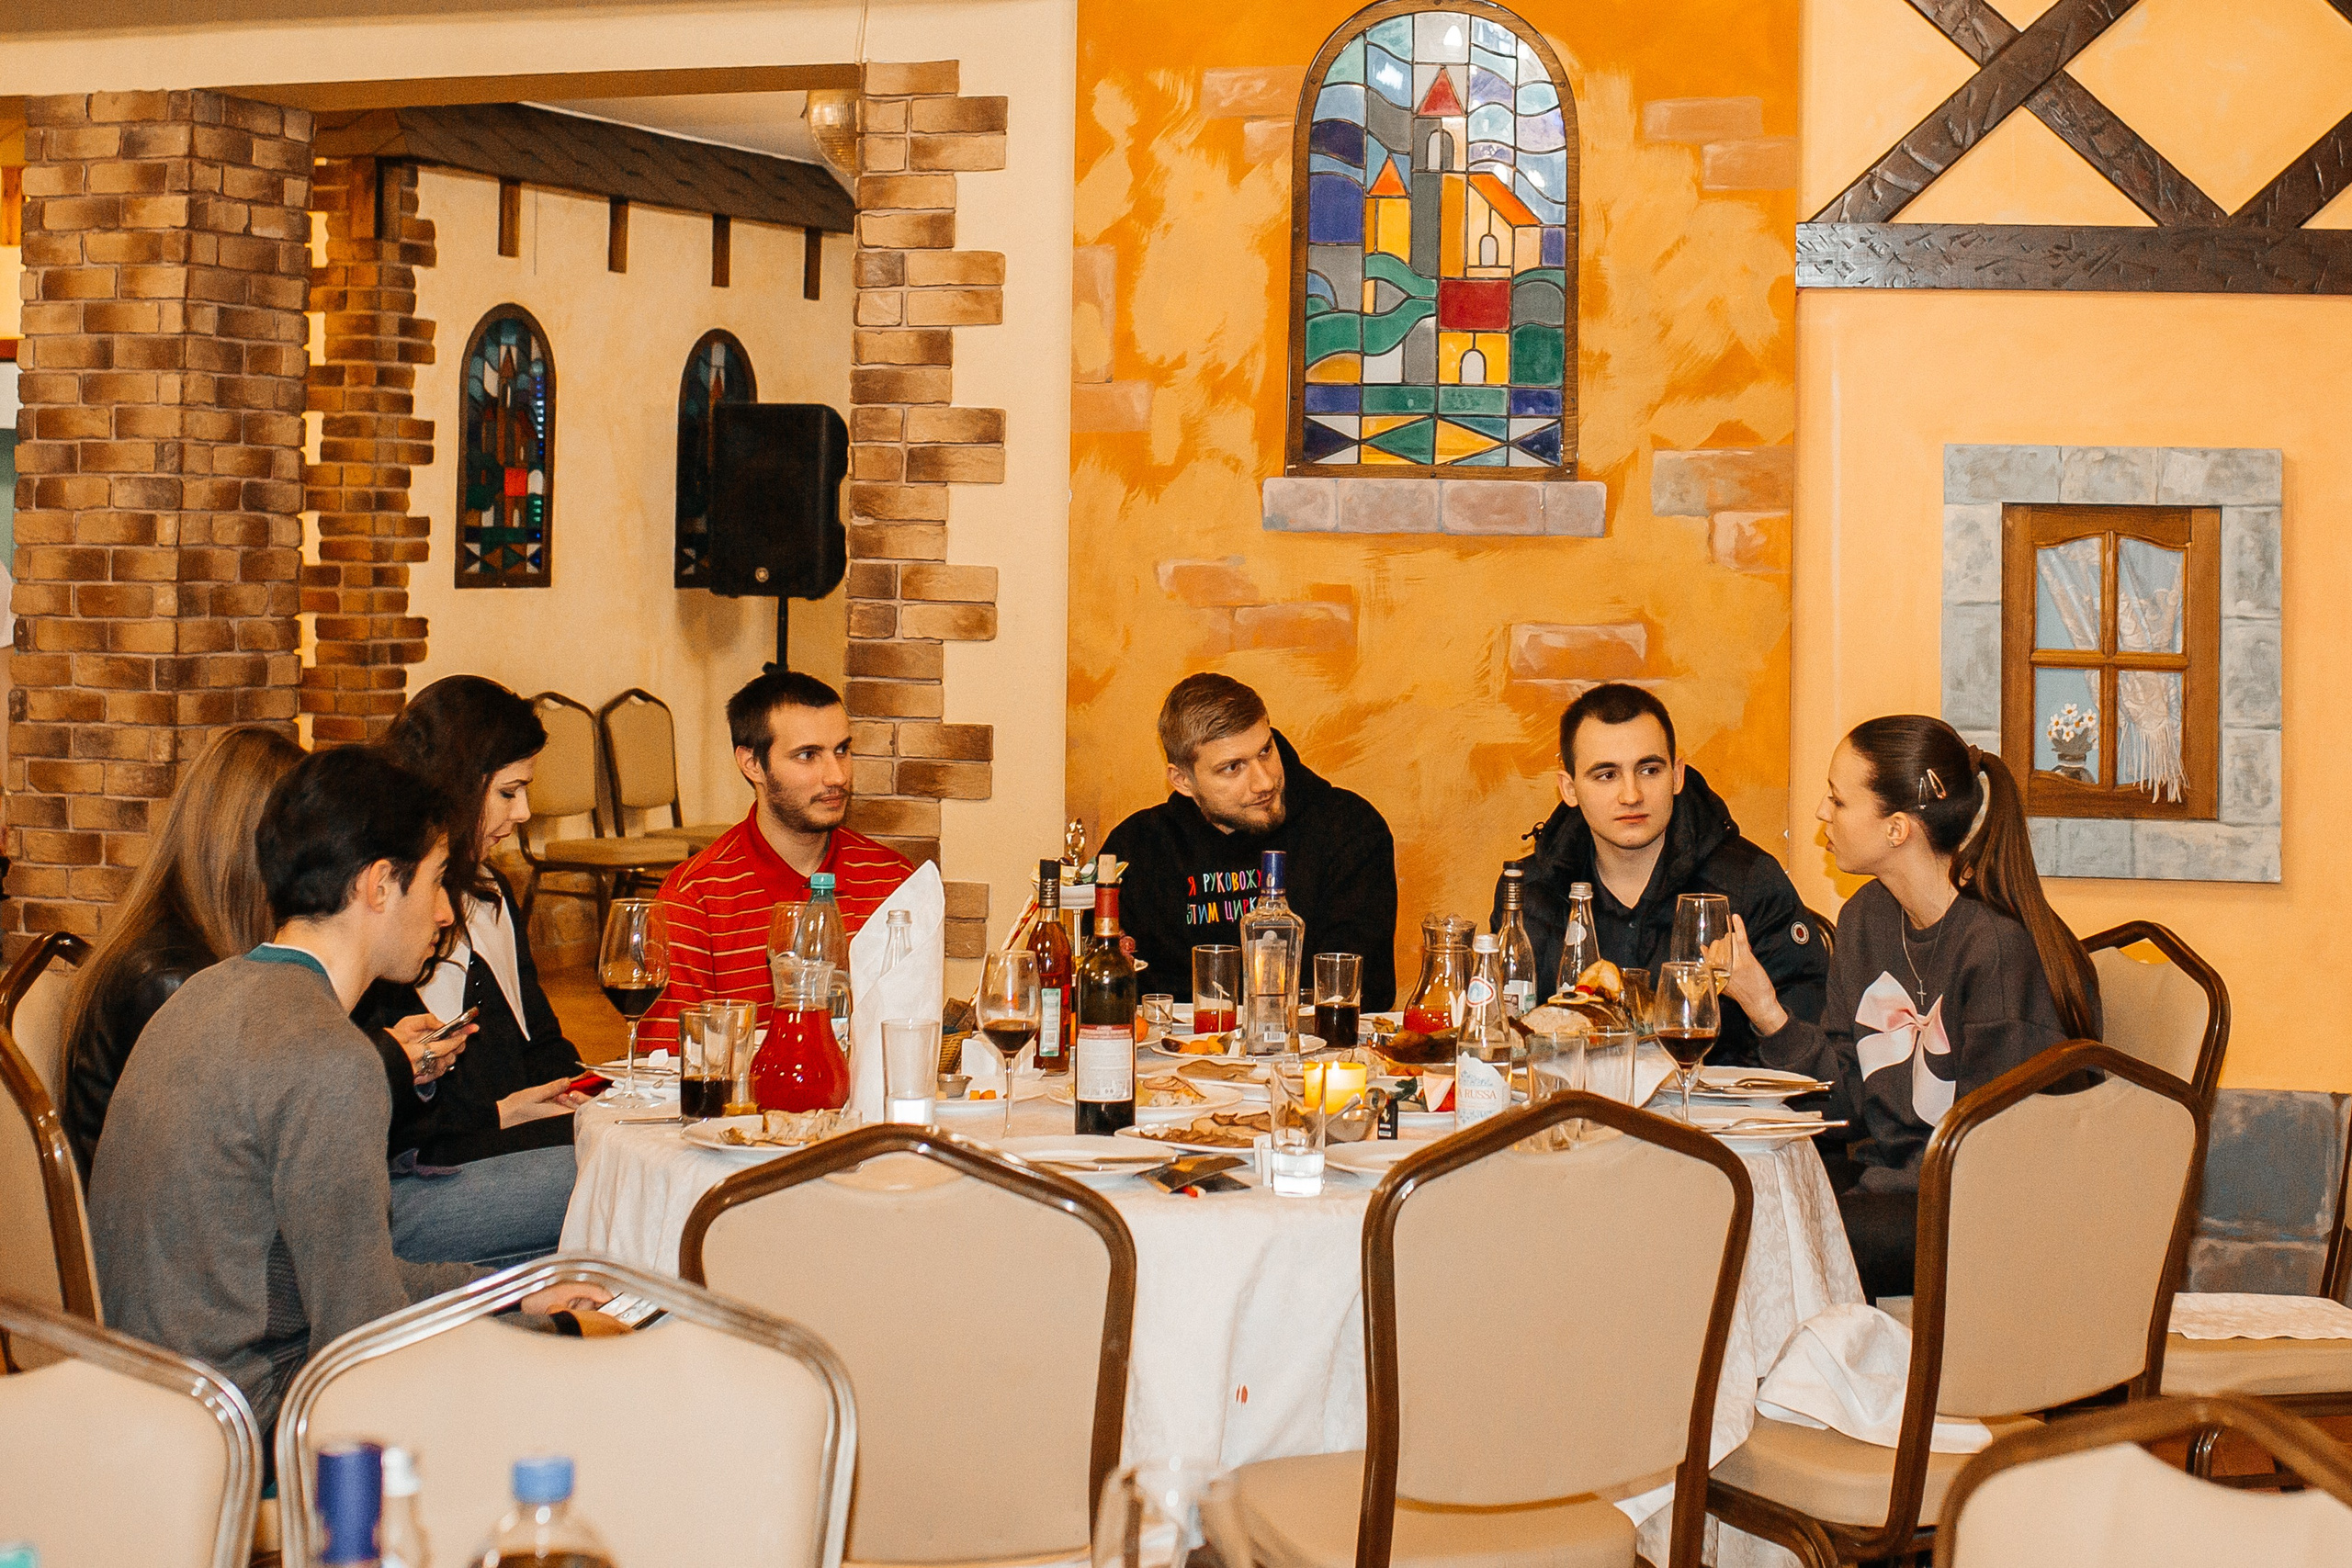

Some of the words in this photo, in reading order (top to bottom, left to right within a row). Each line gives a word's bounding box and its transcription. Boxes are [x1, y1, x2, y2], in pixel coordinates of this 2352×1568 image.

[1187, 875, 1196, 897] Я
[1203, 868, 1262, 894] РУКОВОЖУ
[1224, 896, 1258, 923] ЦИРК
